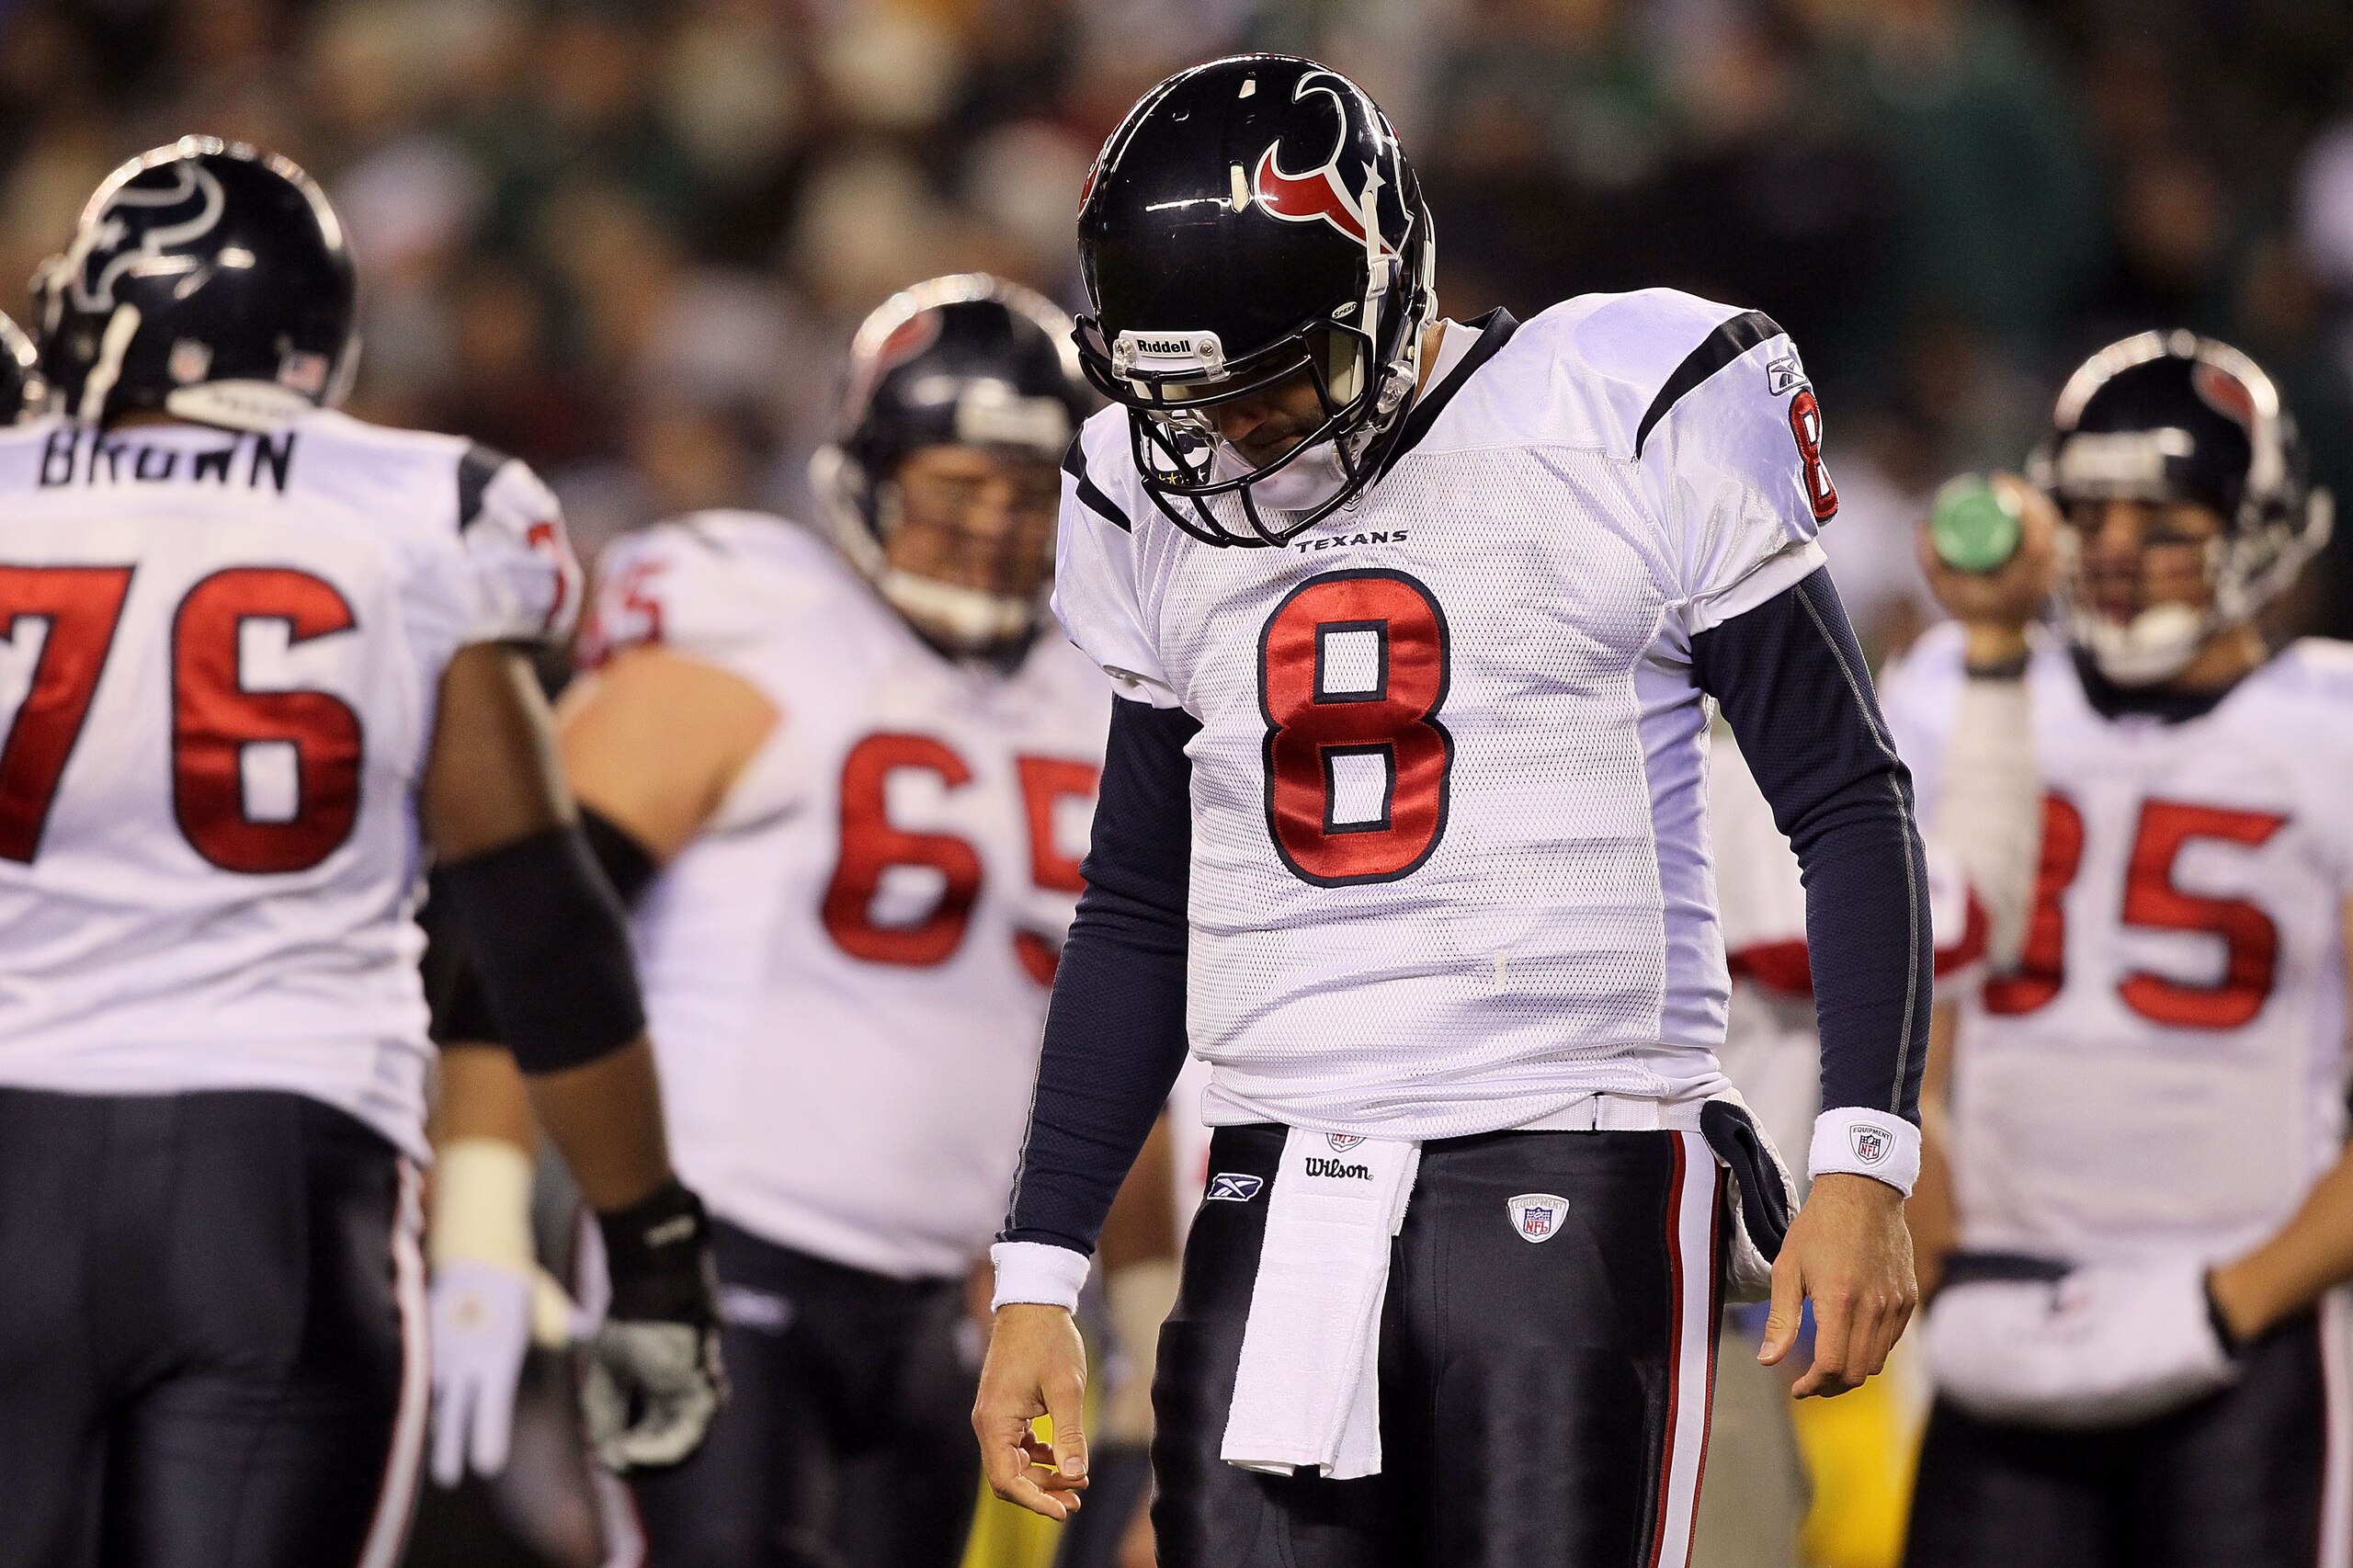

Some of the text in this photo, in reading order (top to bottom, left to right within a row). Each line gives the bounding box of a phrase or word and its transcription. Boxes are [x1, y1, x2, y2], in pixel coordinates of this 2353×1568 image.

[1333, 303, 1357, 318] SPEED
[1137, 340, 1191, 353] Riddell
[1789, 389, 1838, 523] 8
[1295, 530, 1408, 553] TEXANS
[0, 564, 365, 874] 76
[1257, 567, 1455, 889] 8
[1853, 1127, 1890, 1141] EQUIPMENT
[1860, 1143, 1878, 1157] NFL
[1305, 1157, 1370, 1180] Wilson
[1515, 1197, 1563, 1210] EQUIPMENT
[1526, 1221, 1549, 1233] NFL
